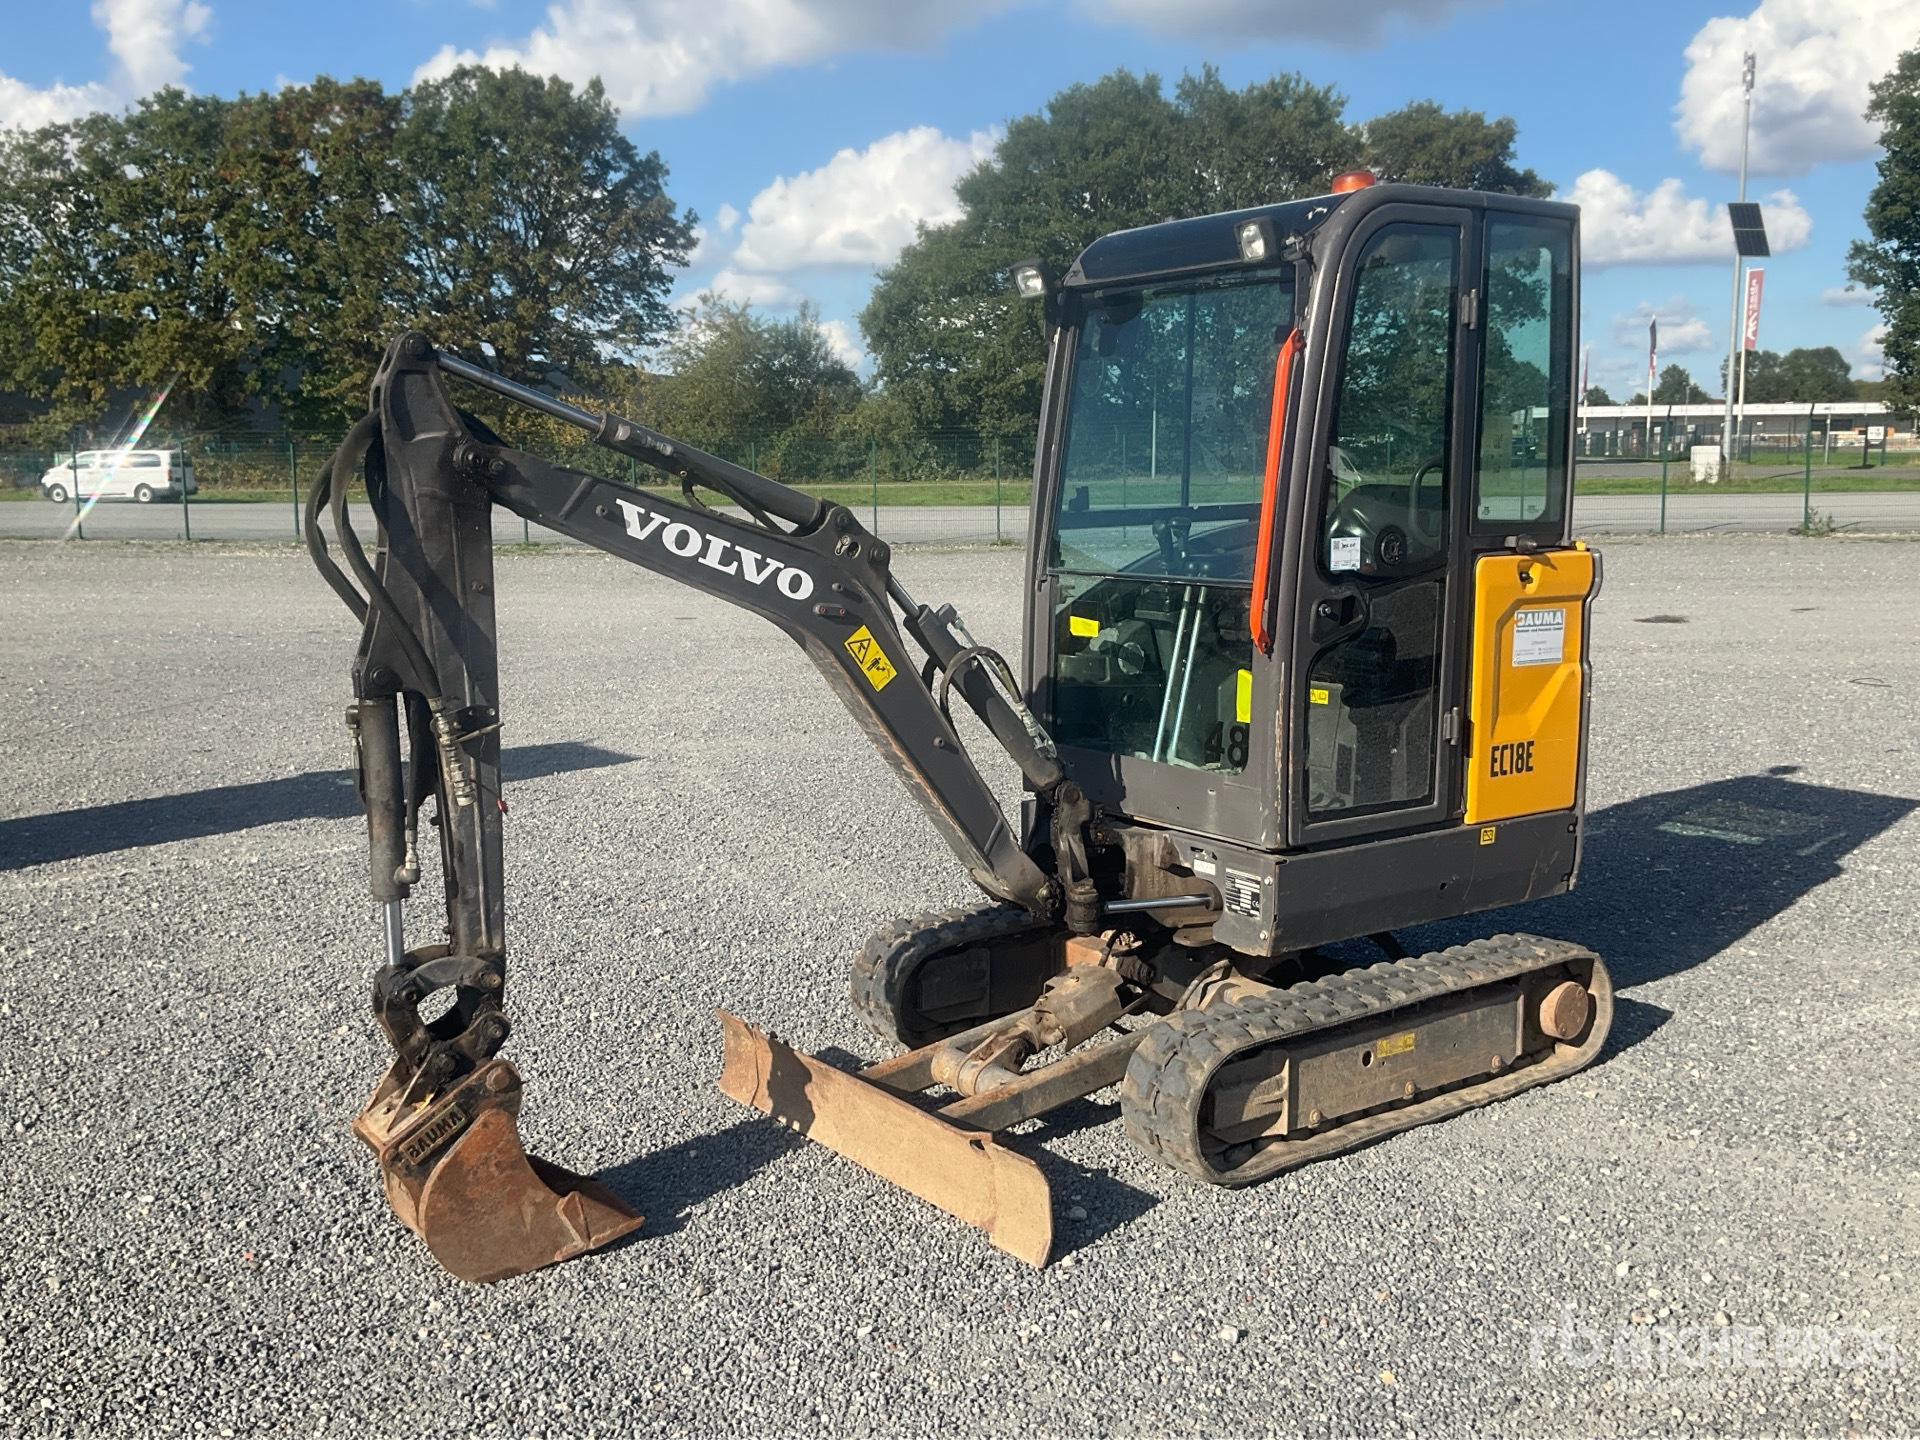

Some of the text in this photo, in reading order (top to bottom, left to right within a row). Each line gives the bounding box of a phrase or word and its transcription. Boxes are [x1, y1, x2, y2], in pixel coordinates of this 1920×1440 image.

[615, 498, 814, 600] VOLVO
[1517, 611, 1563, 627] BAUMA
[1204, 721, 1248, 768] 48
[1490, 741, 1534, 777] EC18E
[406, 1111, 463, 1159] BAUMA
